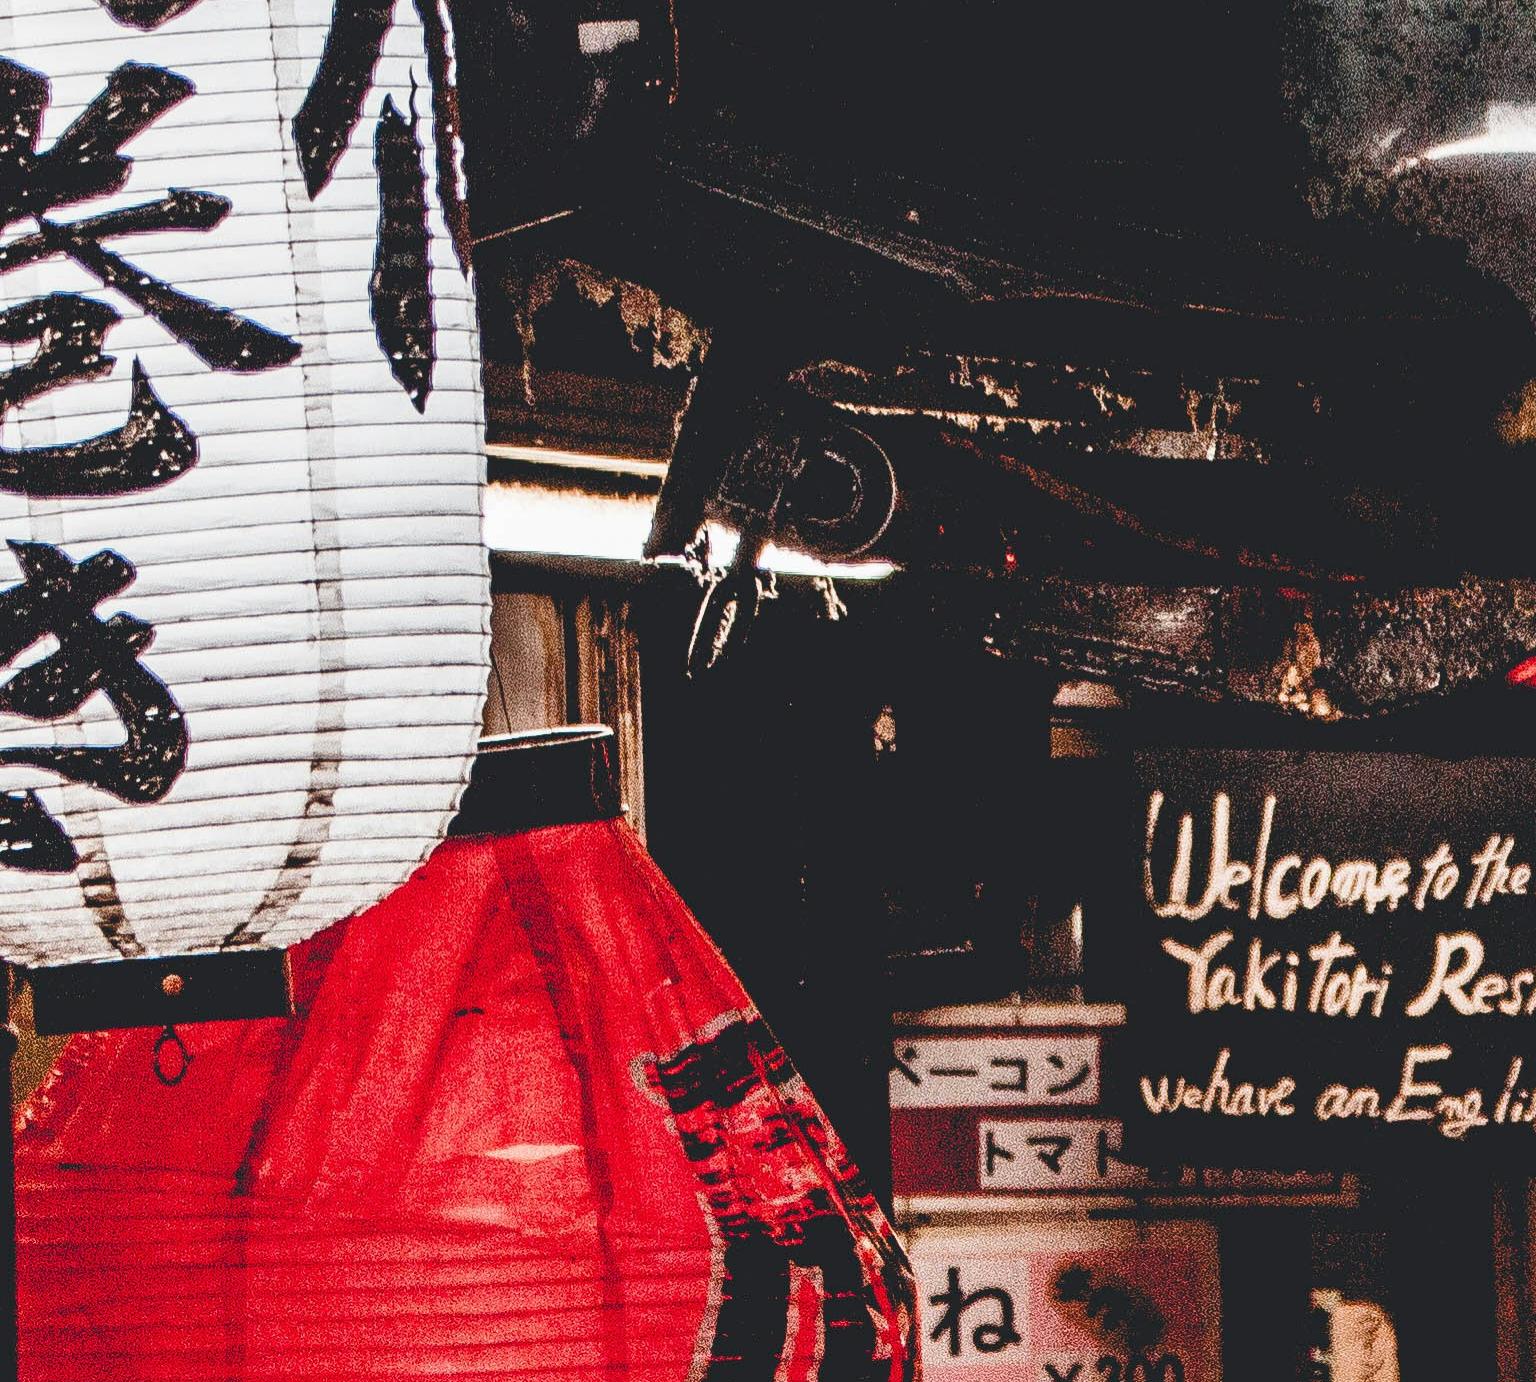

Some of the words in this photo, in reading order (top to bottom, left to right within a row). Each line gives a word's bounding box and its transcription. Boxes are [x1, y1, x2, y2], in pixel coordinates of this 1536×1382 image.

[1143, 790, 1410, 919] Welcome
[1415, 841, 1459, 910] to
[1465, 834, 1530, 909] the
